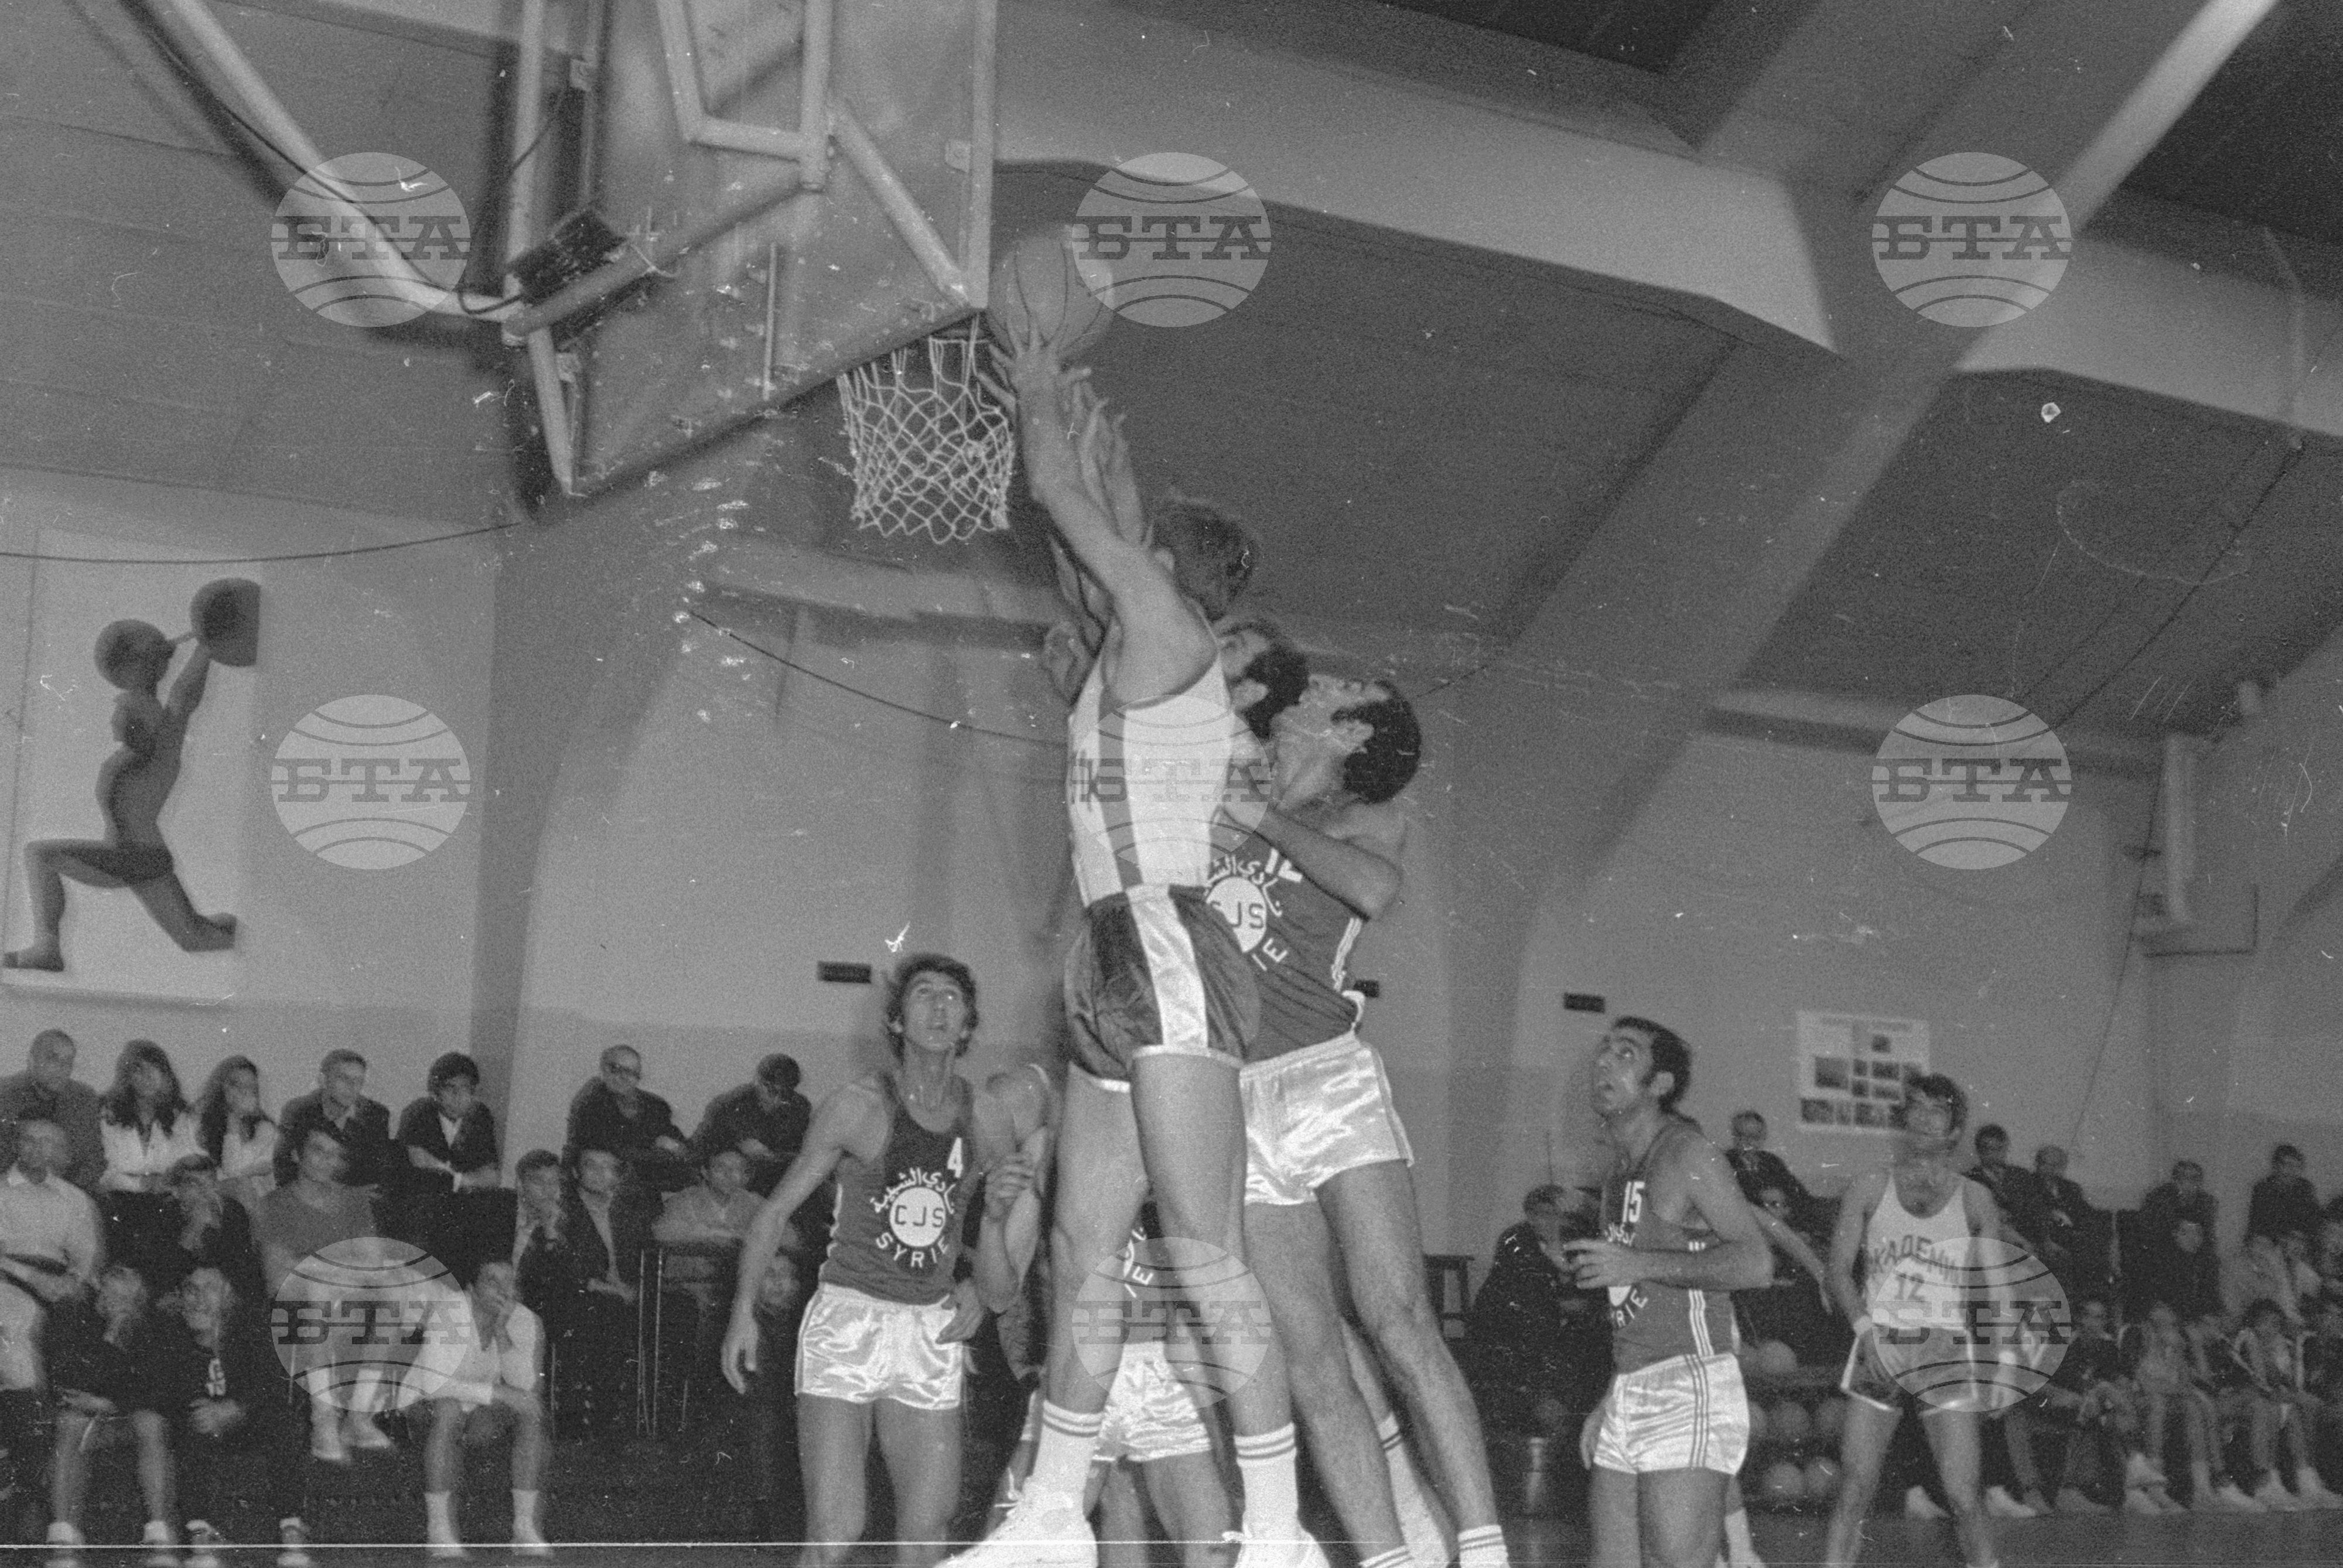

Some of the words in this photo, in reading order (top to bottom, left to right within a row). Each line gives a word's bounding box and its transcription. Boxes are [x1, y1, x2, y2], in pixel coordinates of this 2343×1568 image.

[947, 1137, 964, 1178] 4
[922, 1170, 956, 1214] نادي
[1622, 1181, 1645, 1223] 15
[894, 1204, 944, 1228] CJS
[876, 1231, 949, 1268] SYRIE
[1894, 1273, 1925, 1303] 12
